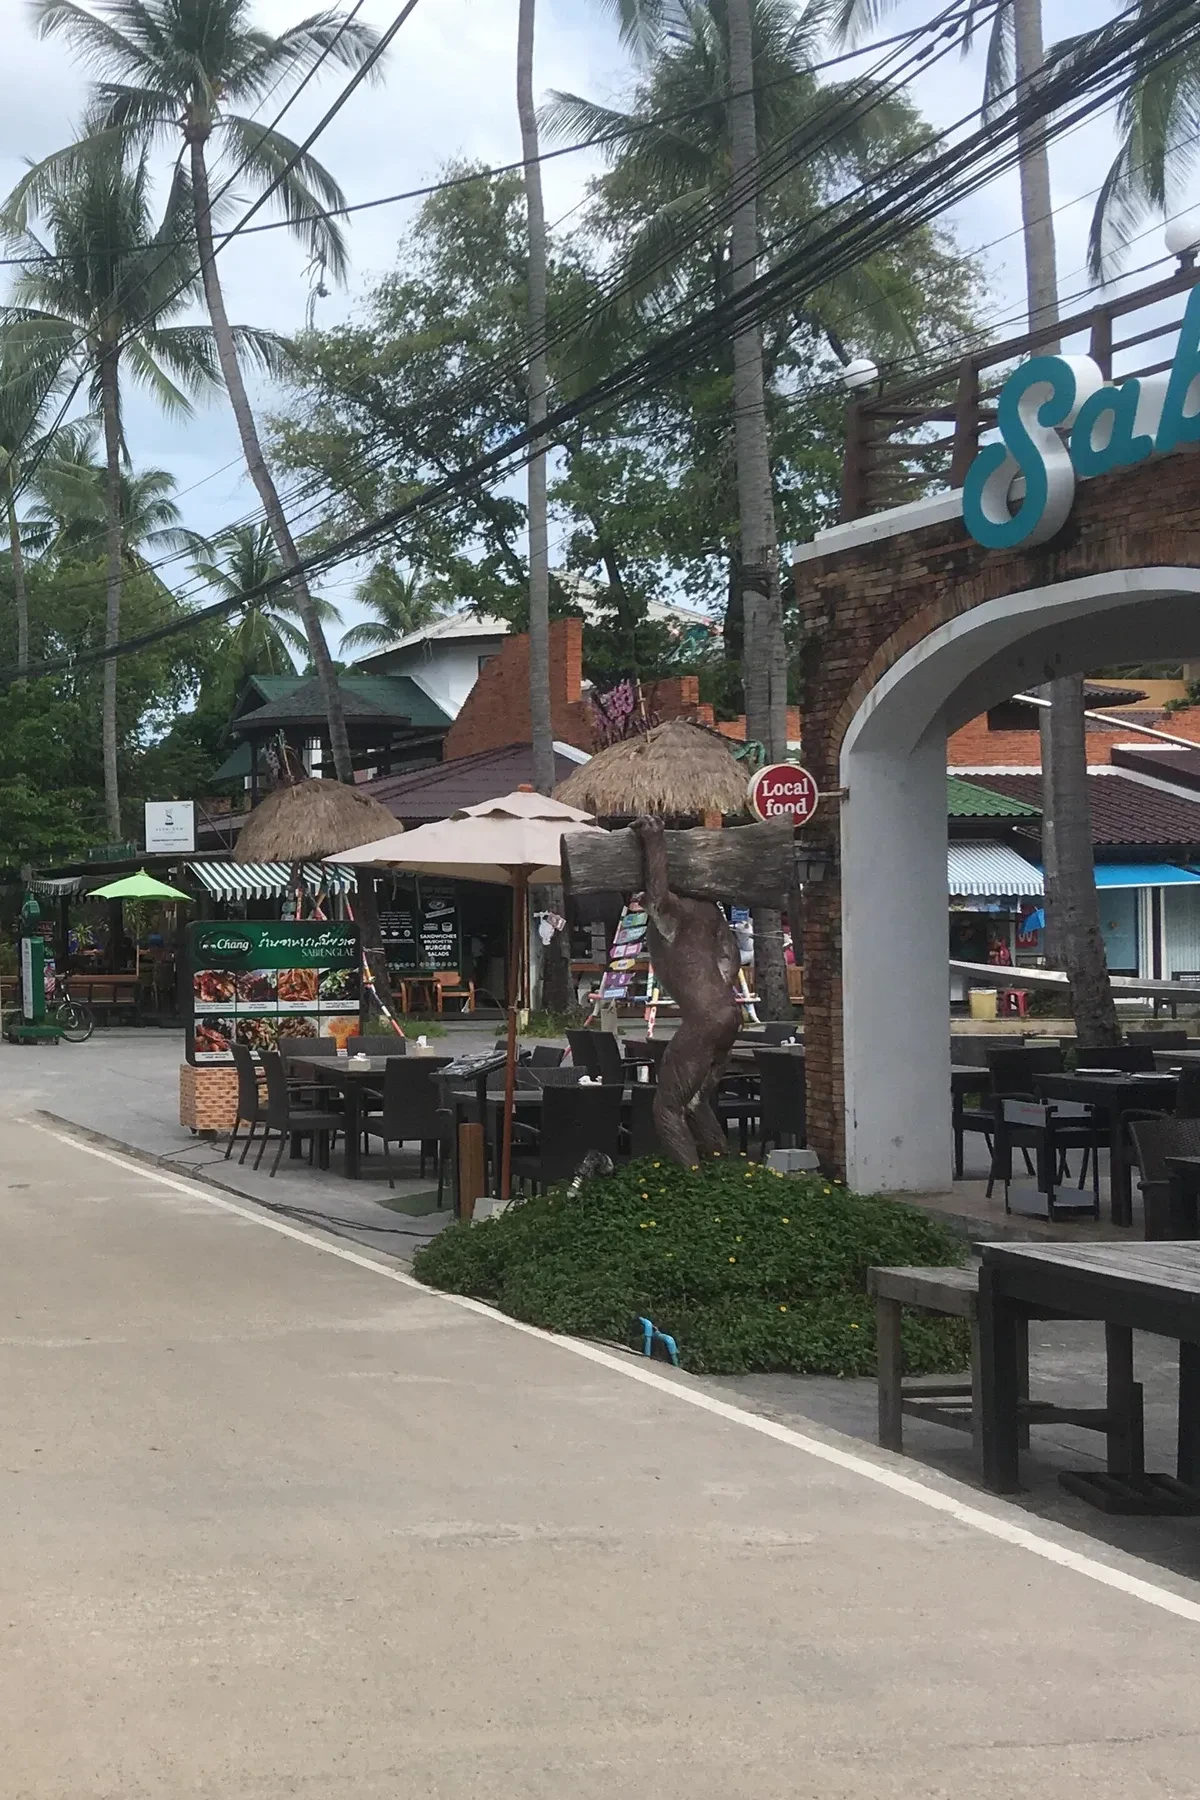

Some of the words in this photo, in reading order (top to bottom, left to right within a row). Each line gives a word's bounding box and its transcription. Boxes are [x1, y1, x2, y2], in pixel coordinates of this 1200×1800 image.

[762, 777, 809, 797] Local
[765, 797, 808, 816] food
[216, 938, 249, 951] Chang
[301, 948, 355, 957] SABIENGLAE
